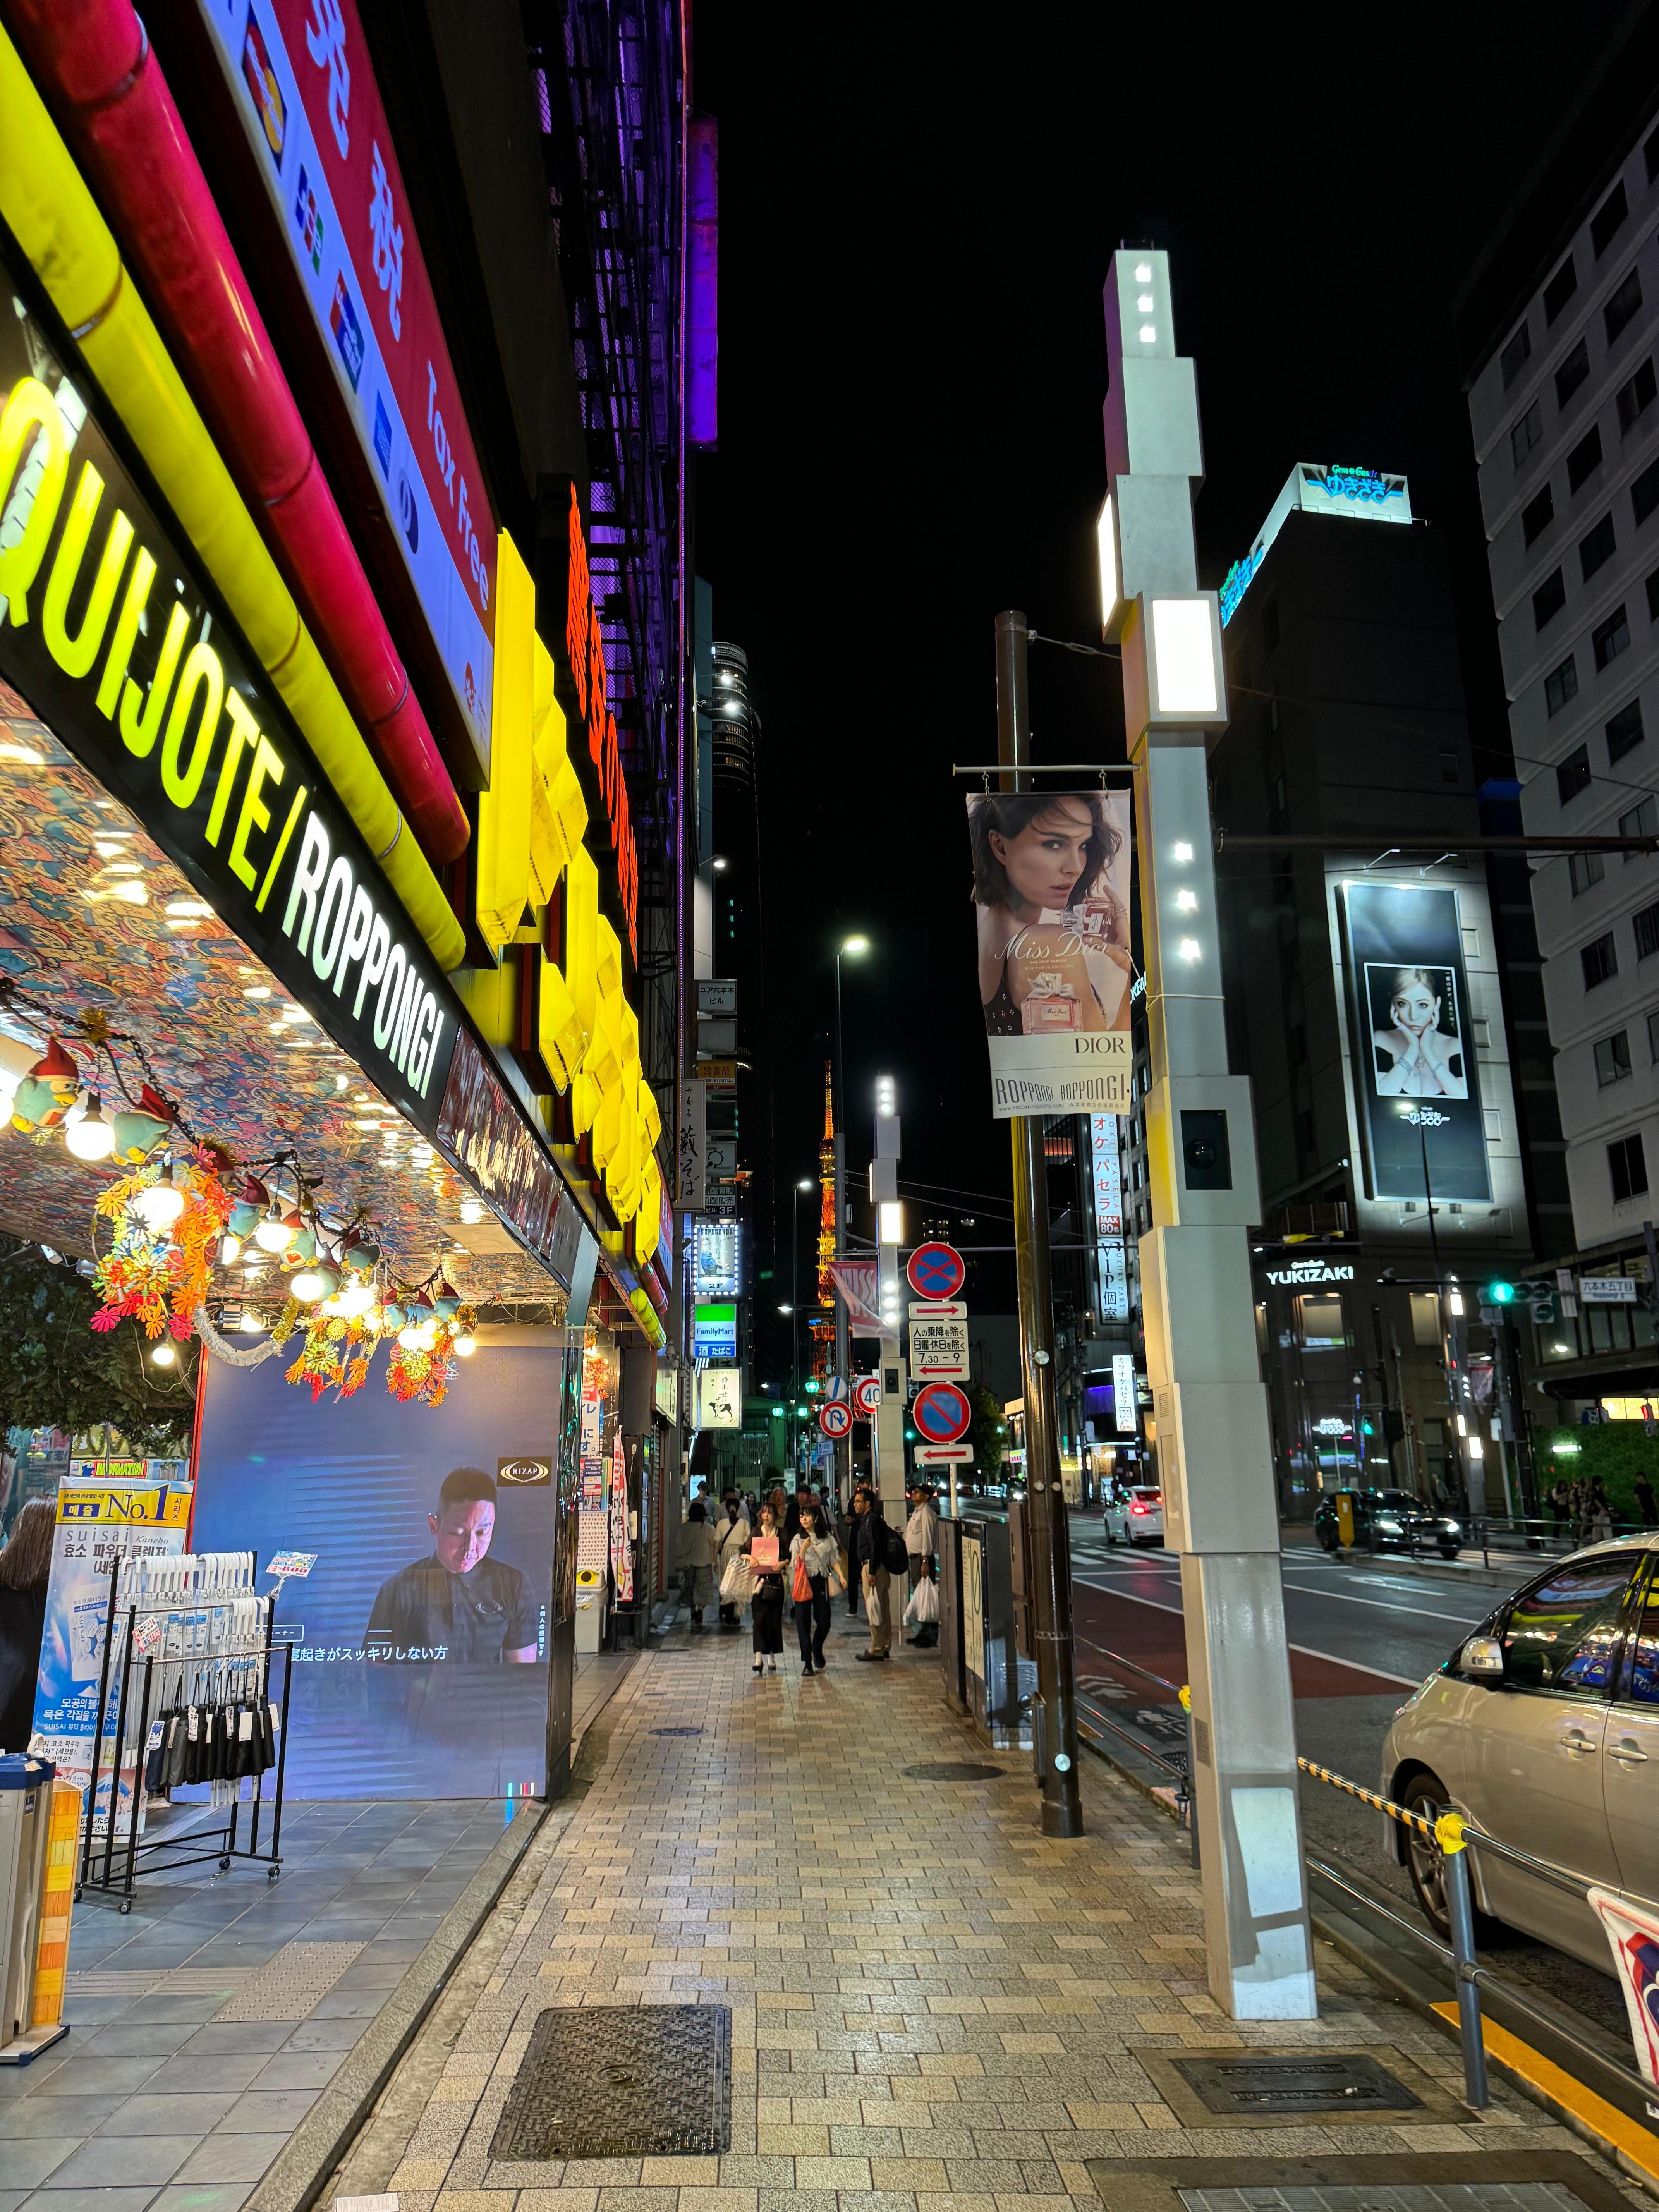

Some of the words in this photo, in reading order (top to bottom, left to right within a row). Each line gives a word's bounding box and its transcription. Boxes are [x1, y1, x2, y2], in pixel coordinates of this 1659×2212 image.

[427, 359, 455, 508] Tax
[458, 474, 489, 611] Free
[1326, 474, 1386, 504] ゆきざき
[0, 376, 285, 895] QUIJOTE
[282, 810, 444, 1099] ROPPONGI
[994, 933, 1050, 960] Miss
[1055, 931, 1109, 957] Dior
[1074, 1037, 1126, 1053] DIOR
[996, 1078, 1054, 1104] ROPPONGI
[1060, 1073, 1125, 1101] ROPPONGI
[1095, 1159, 1111, 1211] パセラ
[1111, 1161, 1120, 1209] PASELA
[719, 1206, 733, 1214] 3F
[1266, 1266, 1354, 1285] YUKIZAKI
[697, 1328, 733, 1336] FamilyMart
[913, 1326, 964, 1337] 人の乗降を除く
[699, 1346, 709, 1356] 酒
[712, 1347, 732, 1355] たばこ
[918, 1353, 939, 1364] 7.30
[953, 1352, 960, 1363] 9
[864, 1388, 881, 1403] 40
[96, 1462, 145, 1476] INORMATION
[105, 1482, 171, 1521] No.1
[172, 1498, 182, 1521] 시리즈
[66, 1527, 129, 1542] suisai
[135, 1535, 169, 1544] Kanebo
[64, 1544, 87, 1558] 효소
[93, 1544, 127, 1558] 파우더
[60, 1698, 88, 1709] 모공의
[66, 1709, 90, 1721] 각질을
